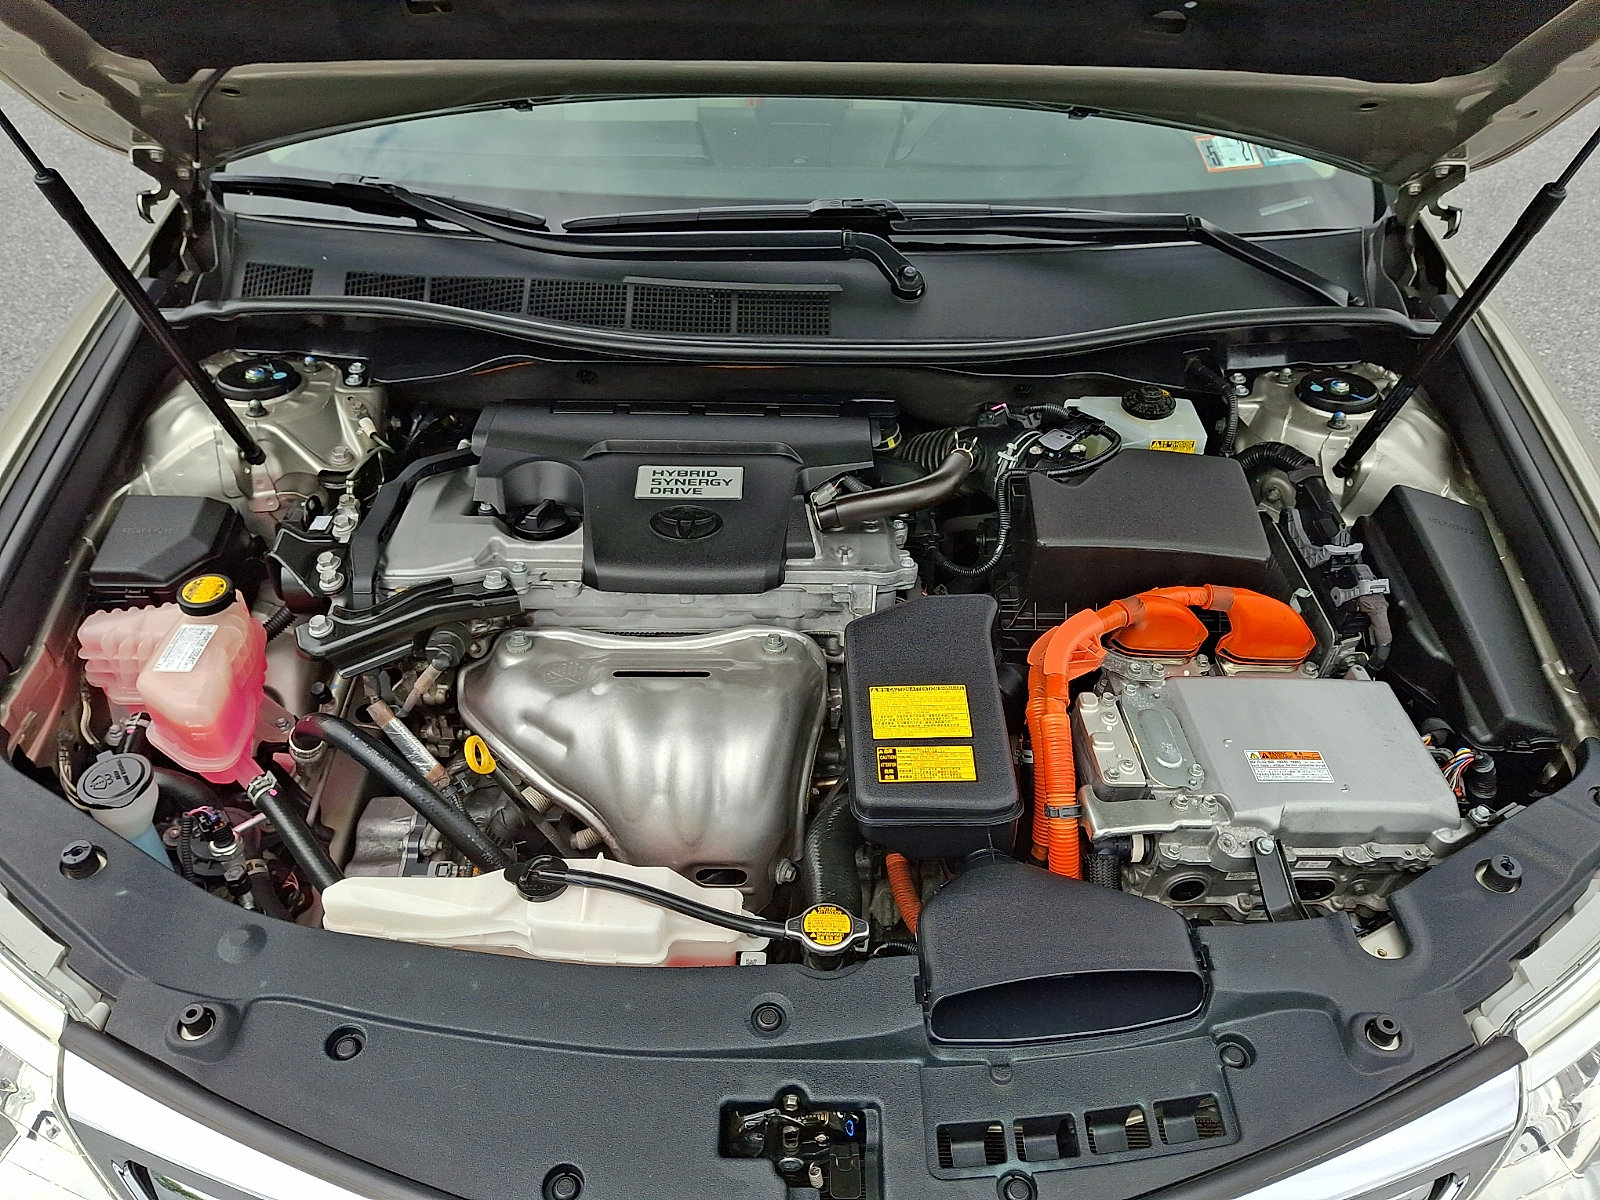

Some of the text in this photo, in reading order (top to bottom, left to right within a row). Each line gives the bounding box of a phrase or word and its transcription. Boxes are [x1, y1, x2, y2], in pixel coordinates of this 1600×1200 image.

[1206, 145, 1221, 166] 5
[651, 478, 733, 486] SYNERGY
[650, 487, 703, 495] DRIVE
